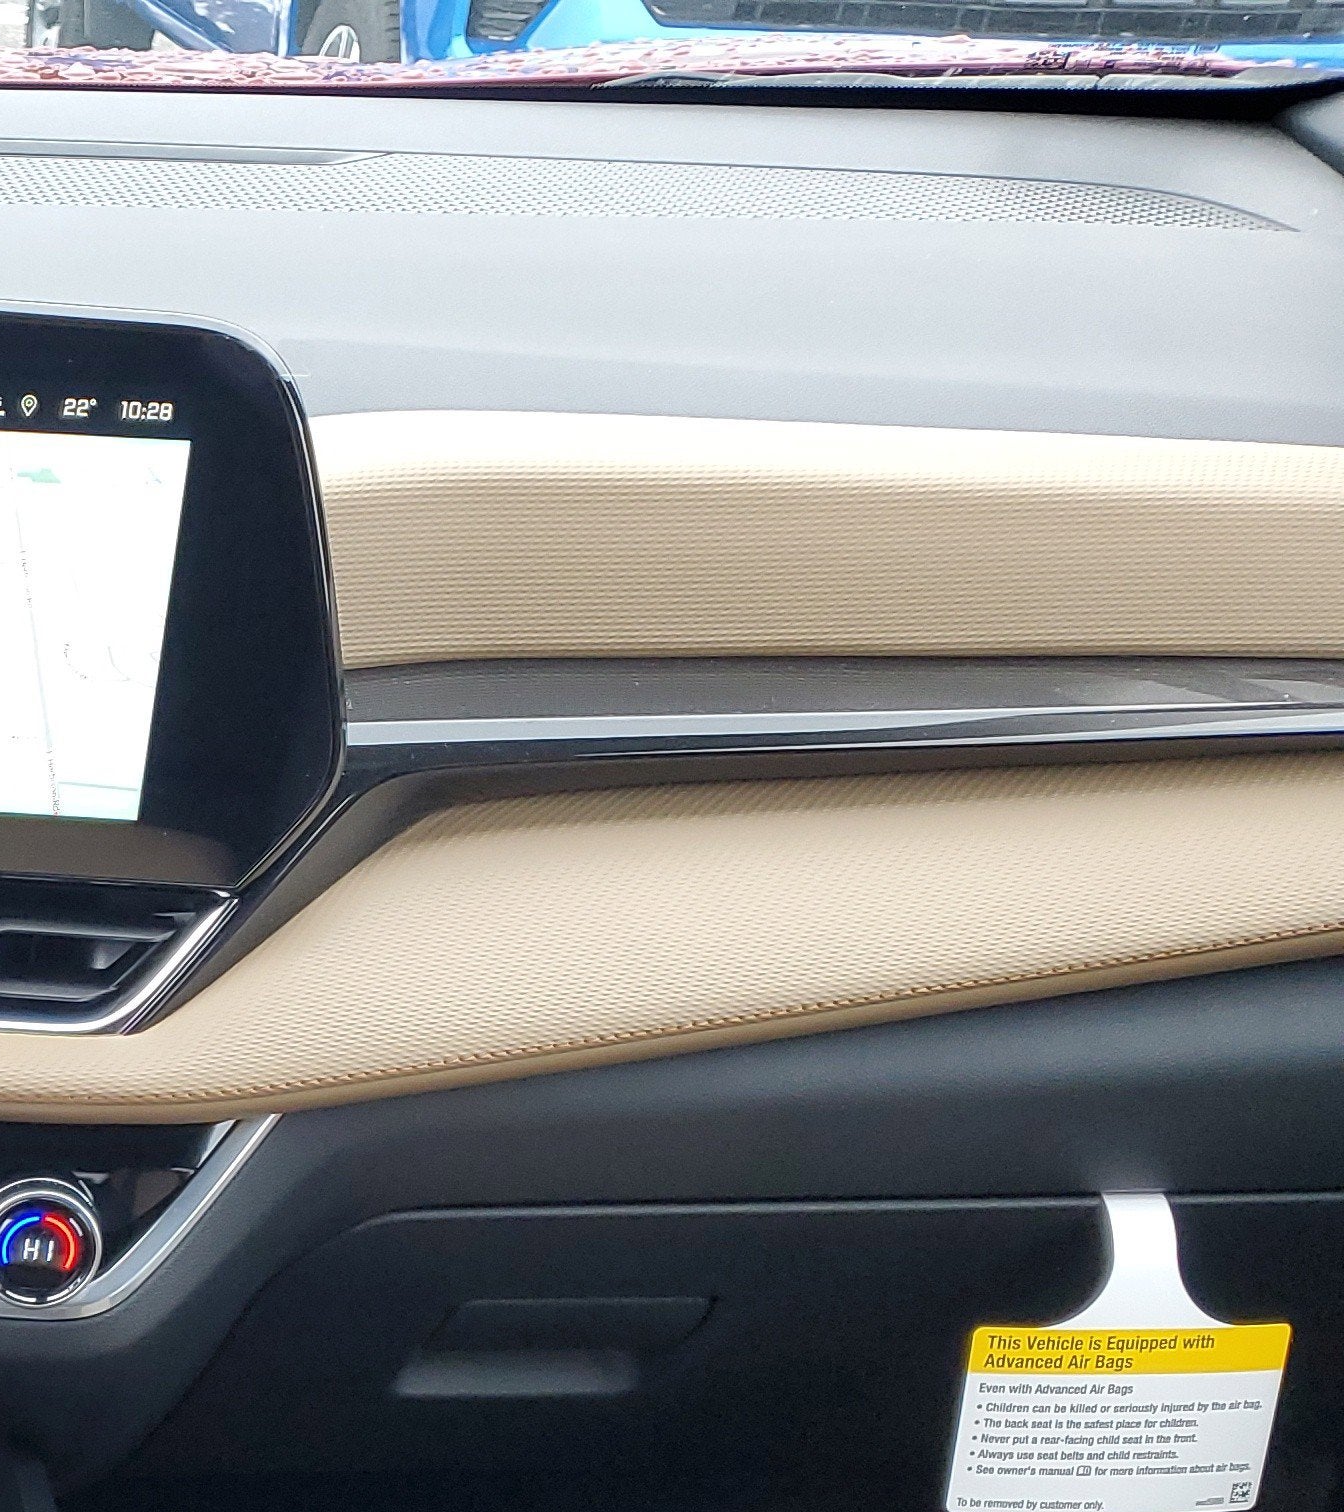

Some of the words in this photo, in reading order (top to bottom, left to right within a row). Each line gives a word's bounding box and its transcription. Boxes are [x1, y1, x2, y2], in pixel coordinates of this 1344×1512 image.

[62, 397, 97, 418] 22°
[119, 400, 173, 421] 10:28
[22, 1237, 55, 1262] HI
[988, 1335, 1021, 1350] This
[1027, 1335, 1084, 1350] Vehicle
[1088, 1335, 1102, 1350] is
[1107, 1335, 1178, 1353] Equipped
[1183, 1334, 1215, 1349] with
[984, 1353, 1063, 1369] Advanced
[1067, 1354, 1091, 1369] Air
[1095, 1354, 1133, 1372] Bags
[979, 1382, 1005, 1394] Even
[1009, 1383, 1032, 1394] with
[1034, 1383, 1086, 1395] Advanced
[1089, 1384, 1105, 1395] Air
[1107, 1384, 1134, 1397] Bags
[985, 1402, 1029, 1413] Children
[1032, 1405, 1051, 1413] can
[1054, 1403, 1067, 1413] be
[1069, 1403, 1097, 1413] killed
[1100, 1405, 1111, 1413] or
[1113, 1402, 1158, 1414] seriously
[1161, 1402, 1195, 1414] injured
[1197, 1401, 1209, 1413] by
[1211, 1400, 1227, 1411] the
[1228, 1400, 1242, 1410] air
[1243, 1399, 1263, 1411] bag.
[984, 1417, 1001, 1428] The
[1004, 1418, 1028, 1429] back
[1031, 1419, 1052, 1429] seat
[1055, 1419, 1063, 1429] is
[1066, 1419, 1082, 1429] the
[1084, 1419, 1113, 1429] safest
[1115, 1419, 1142, 1430] place
[1144, 1419, 1157, 1429] for
[1159, 1418, 1199, 1429] children.
[980, 1433, 1010, 1444] Never
[1012, 1435, 1029, 1445] put
[1040, 1435, 1094, 1446] rear-facing
[1096, 1435, 1120, 1445] child
[1122, 1435, 1142, 1445] seat
[1145, 1434, 1154, 1444] in
[1156, 1434, 1171, 1444] the
[977, 1449, 1014, 1461] Always
[1016, 1451, 1035, 1460] use
[1037, 1451, 1058, 1461] seat
[1060, 1450, 1084, 1461] belts
[1087, 1450, 1105, 1460] and
[1107, 1450, 1130, 1460] child
[975, 1464, 994, 1475] See
[997, 1465, 1036, 1476] owner's
[1038, 1465, 1074, 1476] manual
[1094, 1466, 1106, 1476] for
[1109, 1467, 1133, 1476] more
[1136, 1465, 1188, 1475] information
[1189, 1463, 1214, 1474] about
[1215, 1462, 1228, 1473] air
[957, 1497, 968, 1507] To
[970, 1498, 981, 1508] be
[983, 1498, 1024, 1509] removed
[1026, 1499, 1037, 1510] by
[1039, 1500, 1082, 1510] customer
[1084, 1500, 1105, 1511] only.
